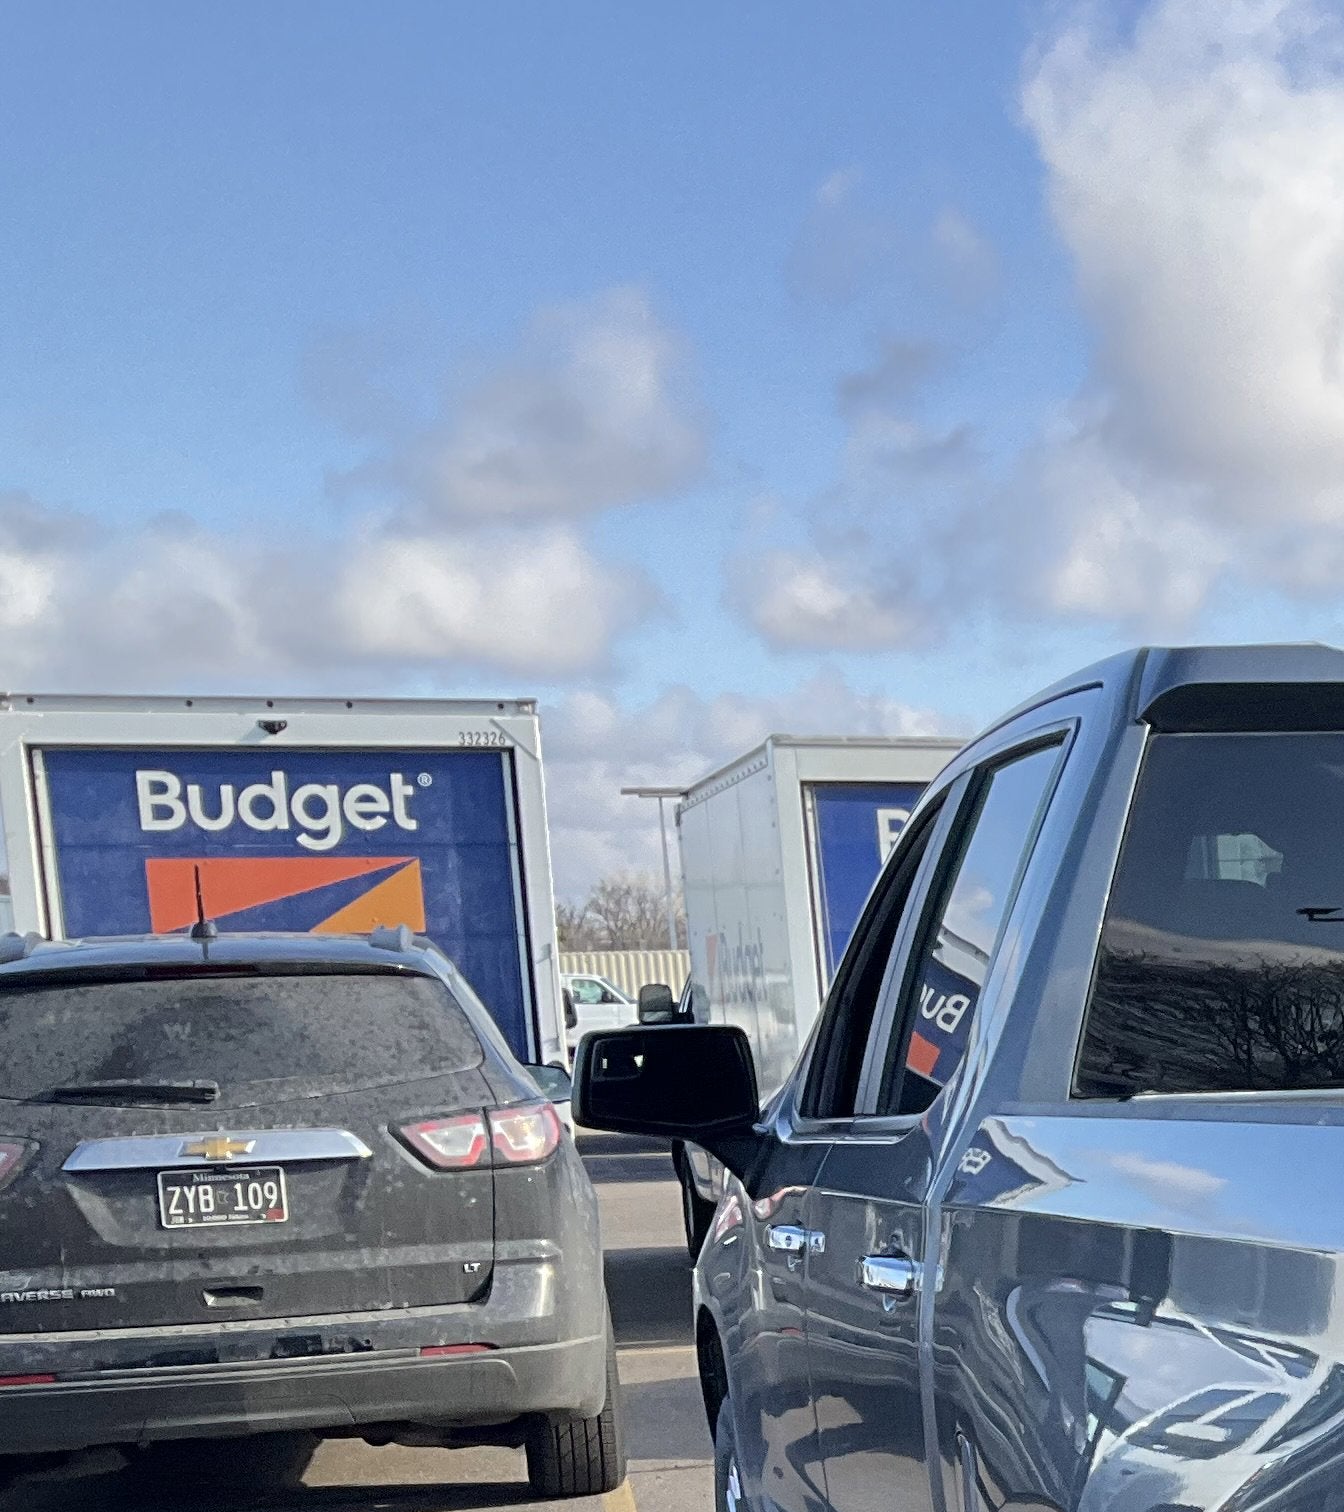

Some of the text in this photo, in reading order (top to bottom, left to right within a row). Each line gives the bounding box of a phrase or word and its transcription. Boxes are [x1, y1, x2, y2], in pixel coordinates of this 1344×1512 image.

[459, 731, 506, 746] 332326
[166, 1181, 278, 1215] ZYB 109
[463, 1262, 481, 1274] LT
